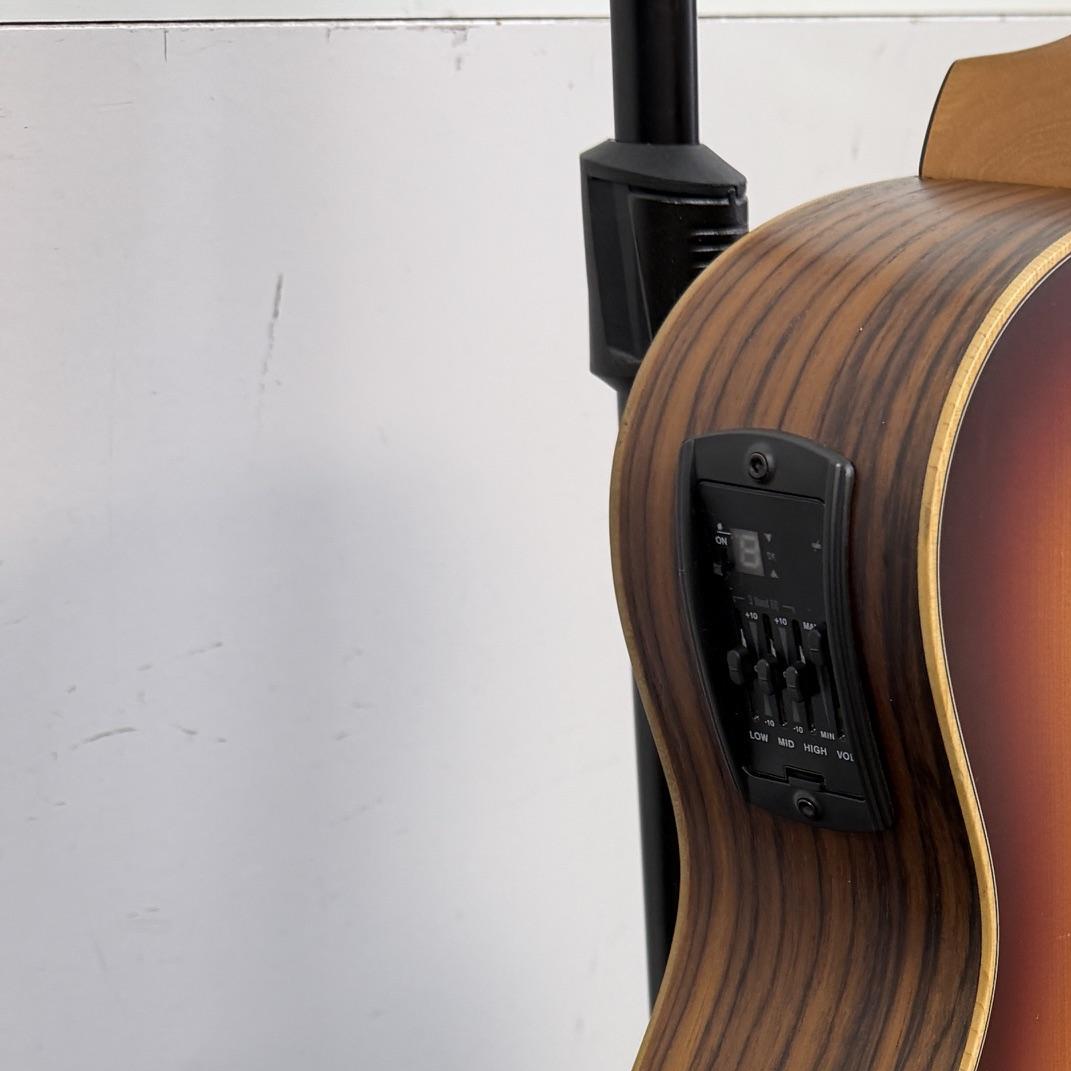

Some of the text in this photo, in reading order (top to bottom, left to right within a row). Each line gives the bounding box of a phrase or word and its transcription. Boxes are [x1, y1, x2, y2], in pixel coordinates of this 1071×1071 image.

[715, 536, 728, 546] ON
[745, 611, 759, 620] +10
[774, 617, 788, 626] +10
[820, 730, 835, 741] MIN
[749, 730, 854, 762] LOW MID HIGH VOL
